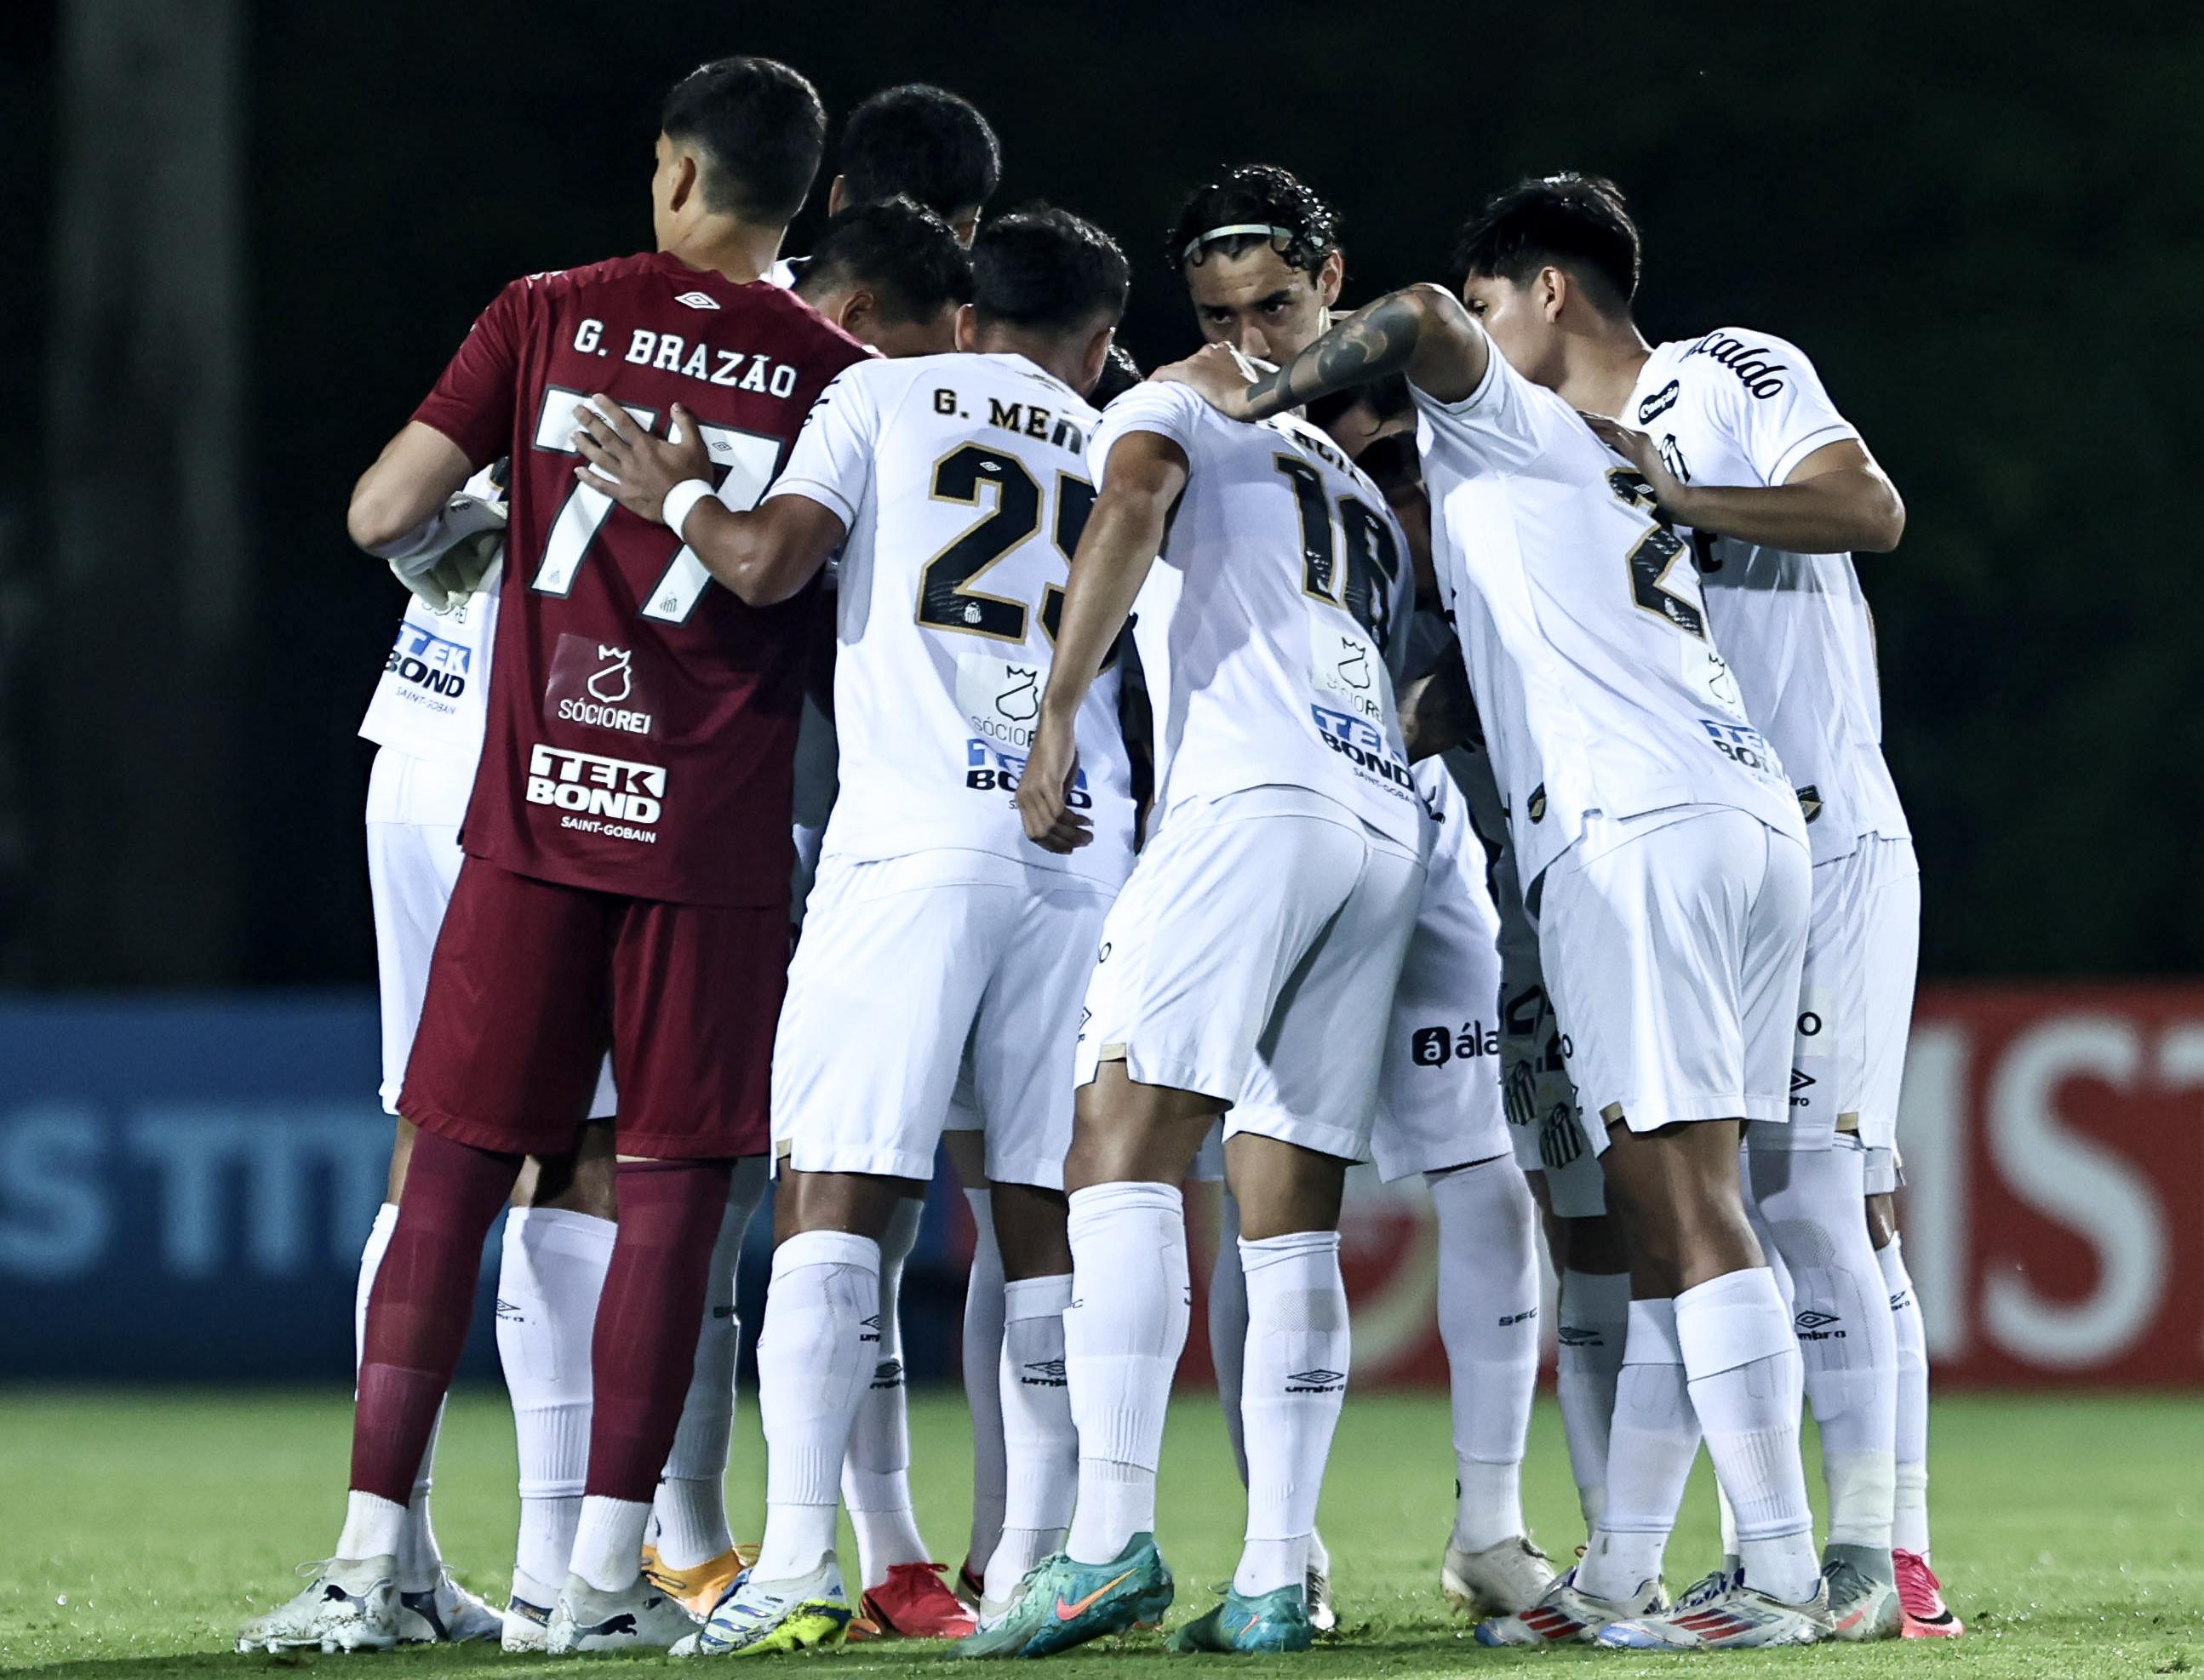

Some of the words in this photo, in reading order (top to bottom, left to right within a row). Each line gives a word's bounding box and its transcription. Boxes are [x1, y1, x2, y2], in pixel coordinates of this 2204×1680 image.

[573, 318, 608, 357] G.
[626, 329, 799, 399] BRAZÃO
[933, 388, 969, 419] G.
[532, 385, 787, 626] 77
[558, 697, 652, 734] SÓCIOREI
[529, 743, 667, 798] TEK
[1319, 727, 1415, 792] BOND
[525, 774, 661, 825] BOND
[560, 815, 657, 844] SAINT-GOBAIN
[1455, 1020, 1500, 1060] ála
